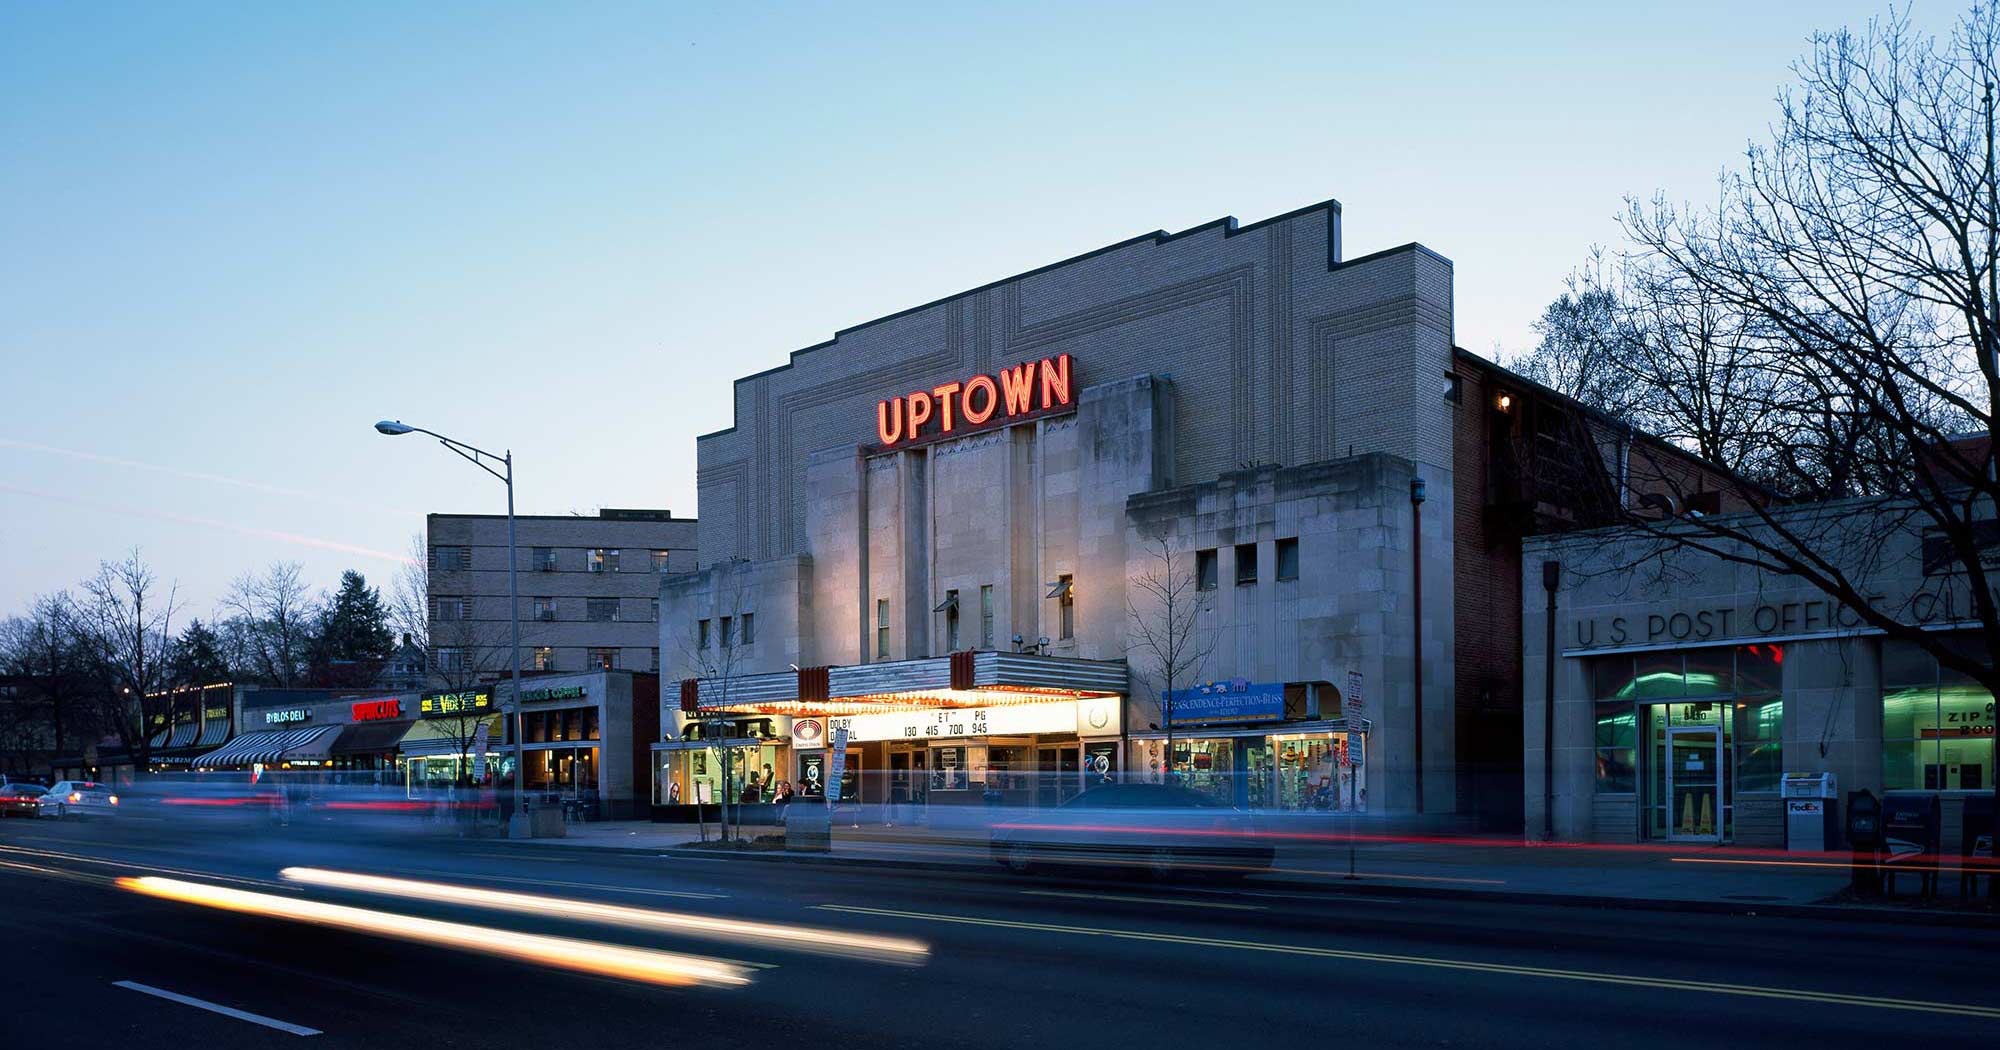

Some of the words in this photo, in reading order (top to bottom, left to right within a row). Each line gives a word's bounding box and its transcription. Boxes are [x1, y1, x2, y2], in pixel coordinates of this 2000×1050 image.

[877, 354, 1070, 445] UPTOWN
[1648, 608, 1735, 640] POST
[1754, 597, 1886, 633] OFFIC
[265, 712, 289, 723] BYBLOS
[290, 709, 305, 721] DELI
[974, 710, 986, 721] PG
[1948, 711, 1980, 722] ZIP
[830, 718, 851, 730] DOLBY
[904, 726, 917, 737] 130
[925, 725, 938, 736] 415
[949, 724, 964, 735] 700
[972, 723, 987, 734] 945
[1789, 803, 1819, 812] FedEx
